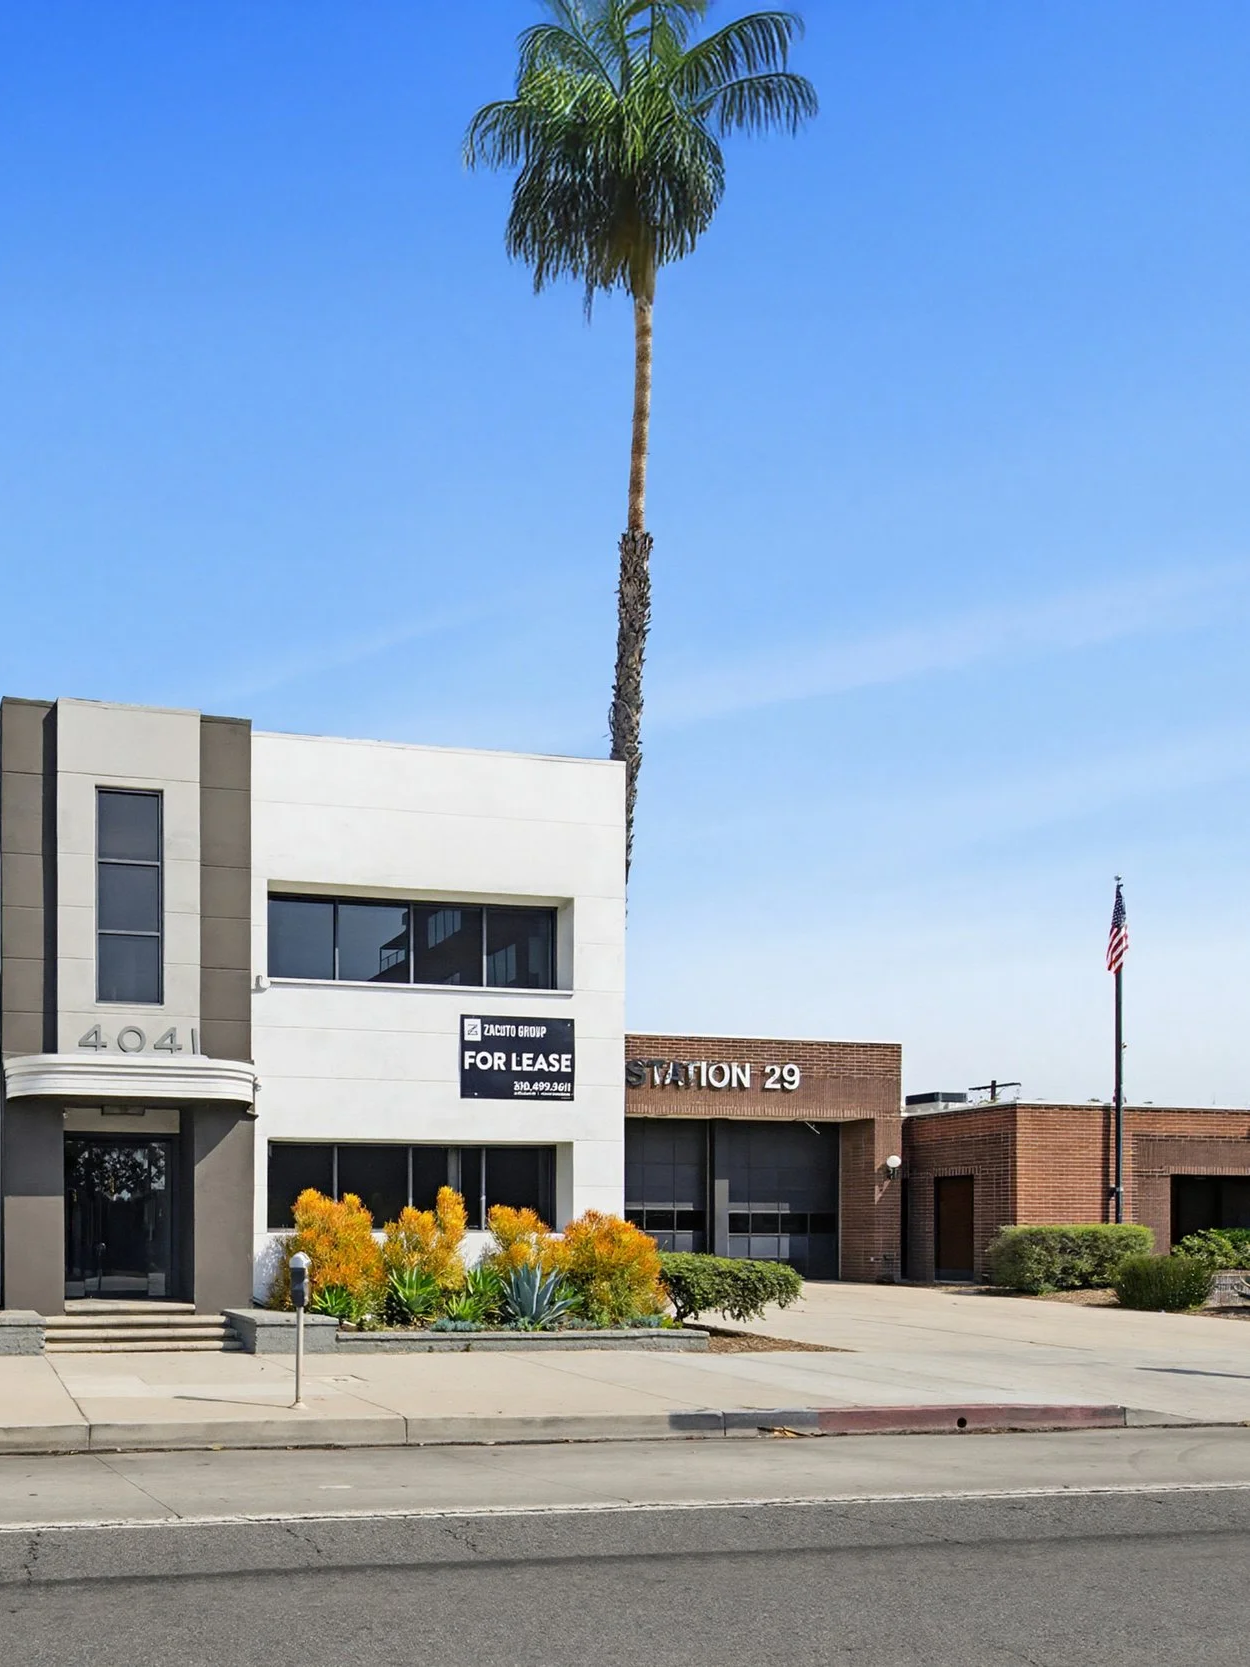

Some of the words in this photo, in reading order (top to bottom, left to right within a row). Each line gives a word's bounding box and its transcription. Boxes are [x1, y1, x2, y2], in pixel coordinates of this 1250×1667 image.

[78, 1024, 198, 1055] 4041
[483, 1024, 516, 1037] ZACUTO
[518, 1025, 547, 1038] GROUP
[464, 1051, 506, 1070] FOR
[511, 1052, 572, 1072] LEASE
[626, 1060, 750, 1089] STATION
[764, 1063, 800, 1090] 29
